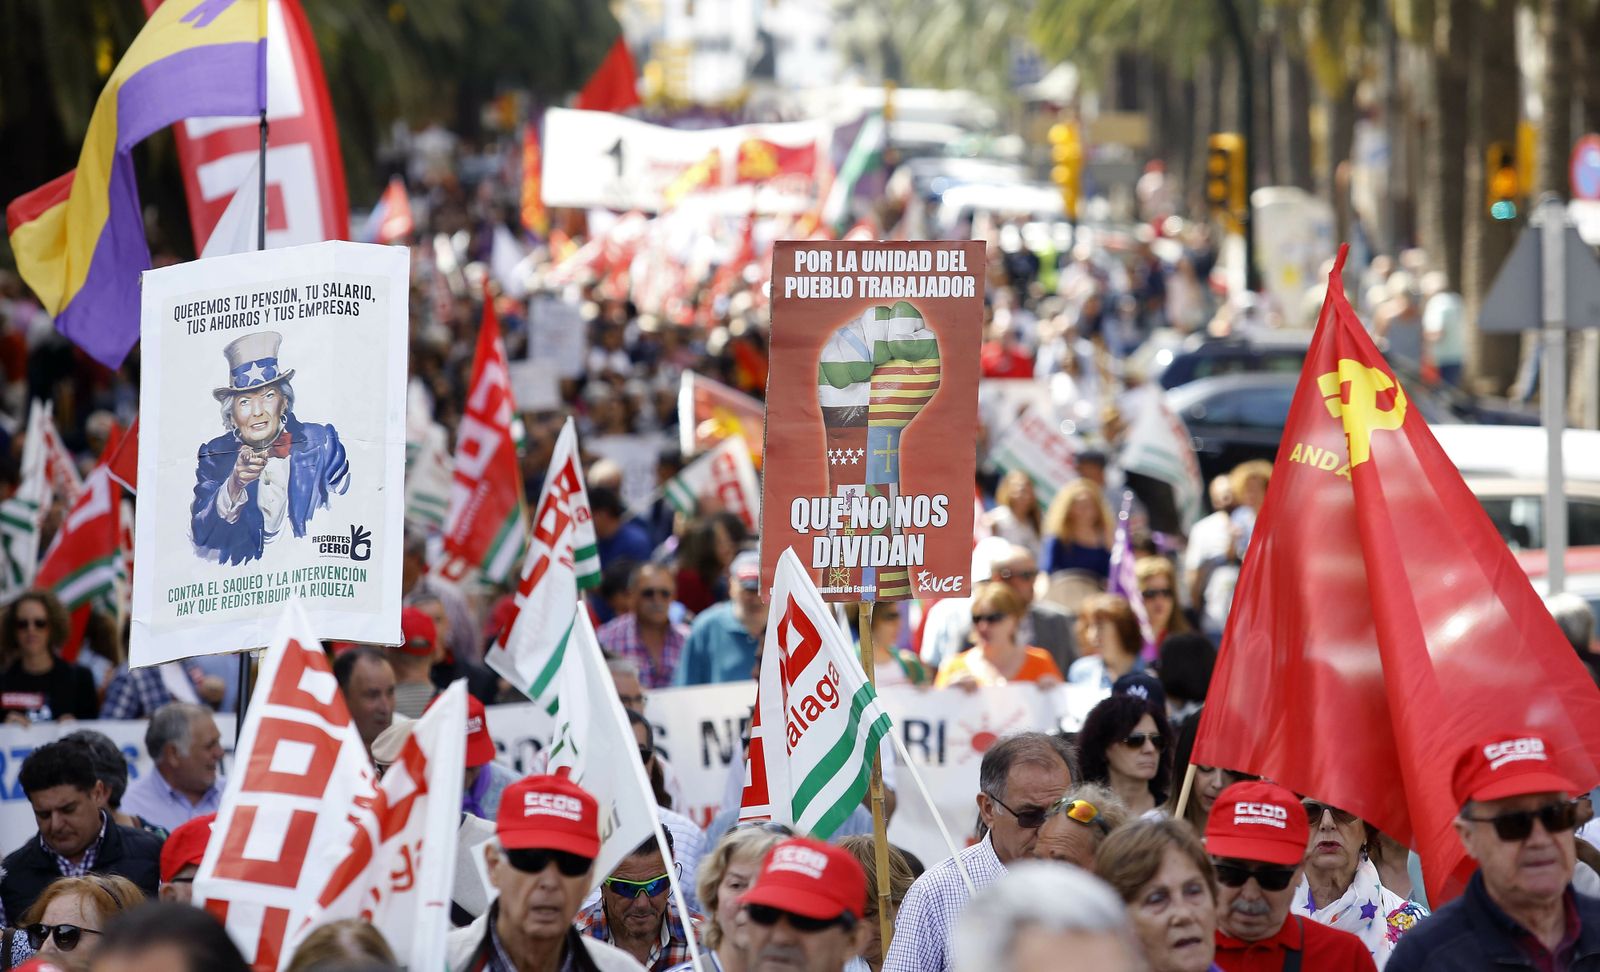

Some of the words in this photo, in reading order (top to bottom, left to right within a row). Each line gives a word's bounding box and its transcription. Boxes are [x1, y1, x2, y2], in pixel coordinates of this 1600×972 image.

[794, 250, 832, 272] POR
[836, 250, 858, 272] LA
[861, 250, 932, 272] UNIDAD
[936, 250, 967, 272] DEL
[784, 276, 853, 298] PUEBLO
[857, 276, 975, 298] TRABAJADOR
[174, 297, 230, 322] QUEREMOS
[235, 295, 248, 311] TU
[251, 287, 301, 308] PENSIÓN,
[305, 284, 319, 301] TU
[322, 282, 376, 303] SALARIO,
[186, 318, 206, 335] TUS
[209, 310, 260, 331] AHORROS
[264, 308, 270, 323] Y
[273, 305, 294, 321] TUS
[298, 299, 360, 319] EMPRESAS
[790, 496, 845, 534] QUE
[850, 495, 889, 530] NO
[894, 494, 949, 528] NOS
[312, 534, 351, 544] RECORTES
[319, 543, 350, 555] CERO
[812, 534, 925, 569] DIVIDAN
[168, 583, 204, 603] CONTRA
[207, 581, 219, 596] EL
[223, 574, 263, 593] SAQUEO
[266, 573, 273, 587] Y
[276, 572, 288, 586] LA
[292, 565, 367, 584] INTERVENCIÓN
[844, 585, 852, 593] de
[853, 584, 877, 594] España
[931, 574, 964, 592] UCE
[177, 601, 195, 617] HAY
[199, 598, 217, 614] QUE
[221, 587, 291, 610] REDISTRIBUIR
[310, 582, 355, 598] RIQUEZA
[1483, 737, 1545, 761] CCOO
[524, 791, 583, 812] CCOO
[1235, 802, 1288, 820] CCOO
